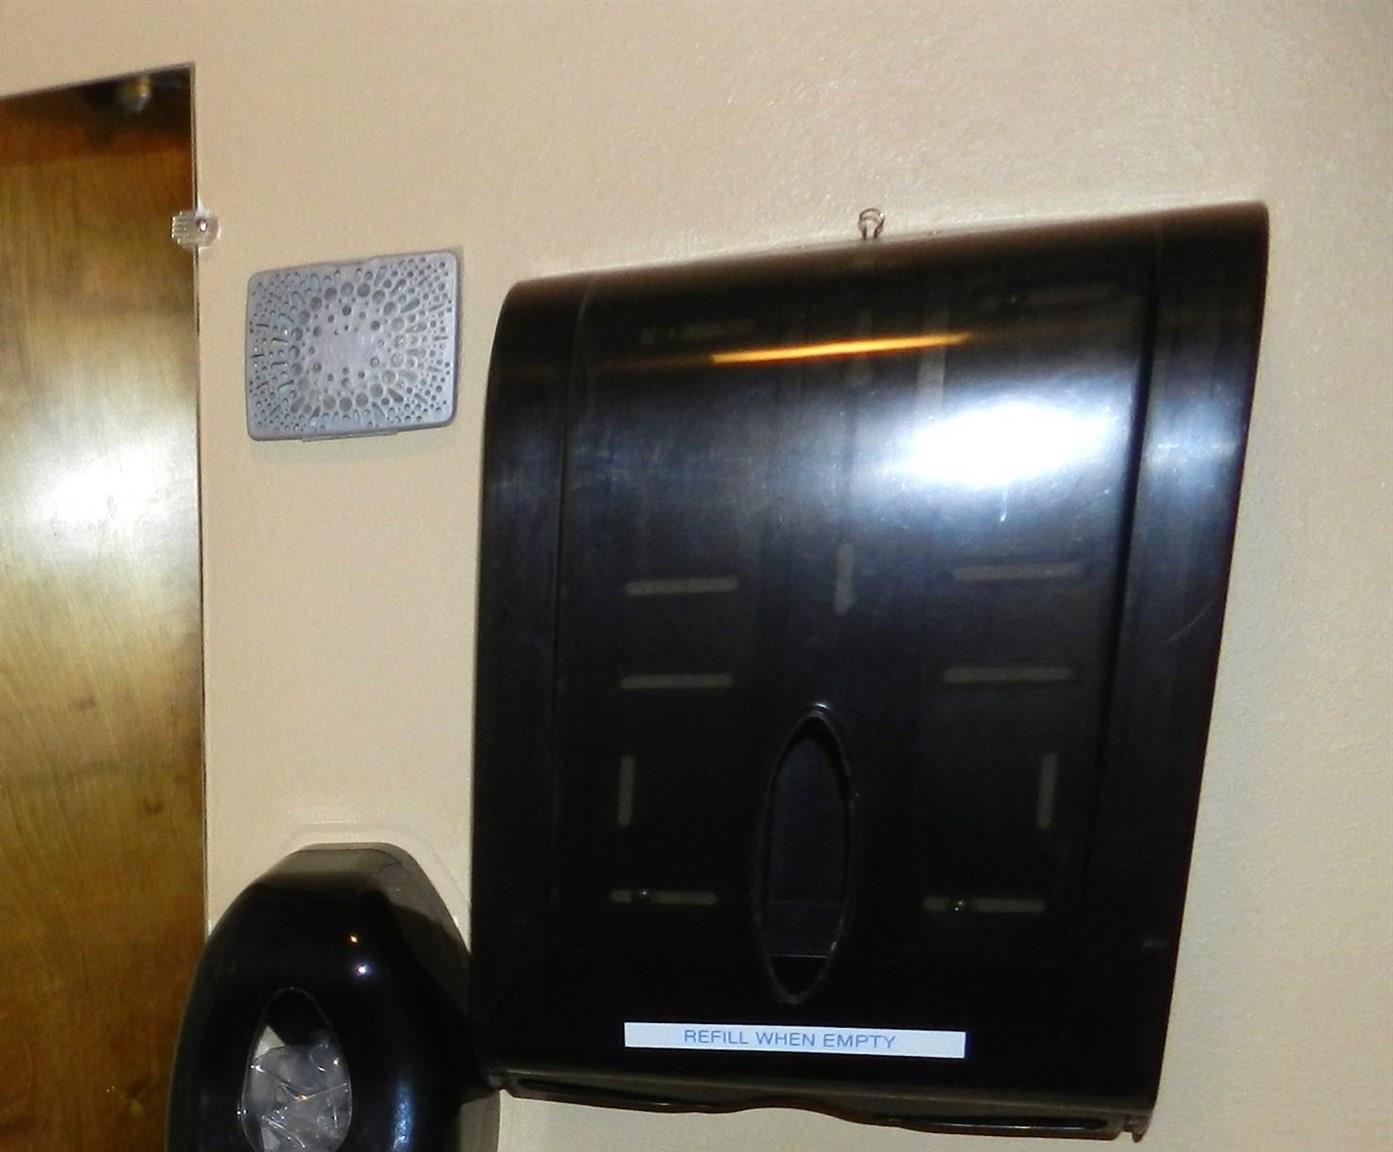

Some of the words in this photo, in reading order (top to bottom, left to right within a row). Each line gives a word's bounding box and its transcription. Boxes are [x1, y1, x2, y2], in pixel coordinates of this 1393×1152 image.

[683, 1028, 749, 1046] REFILL
[755, 1031, 816, 1048] WHEN
[823, 1033, 897, 1050] EMPTY
